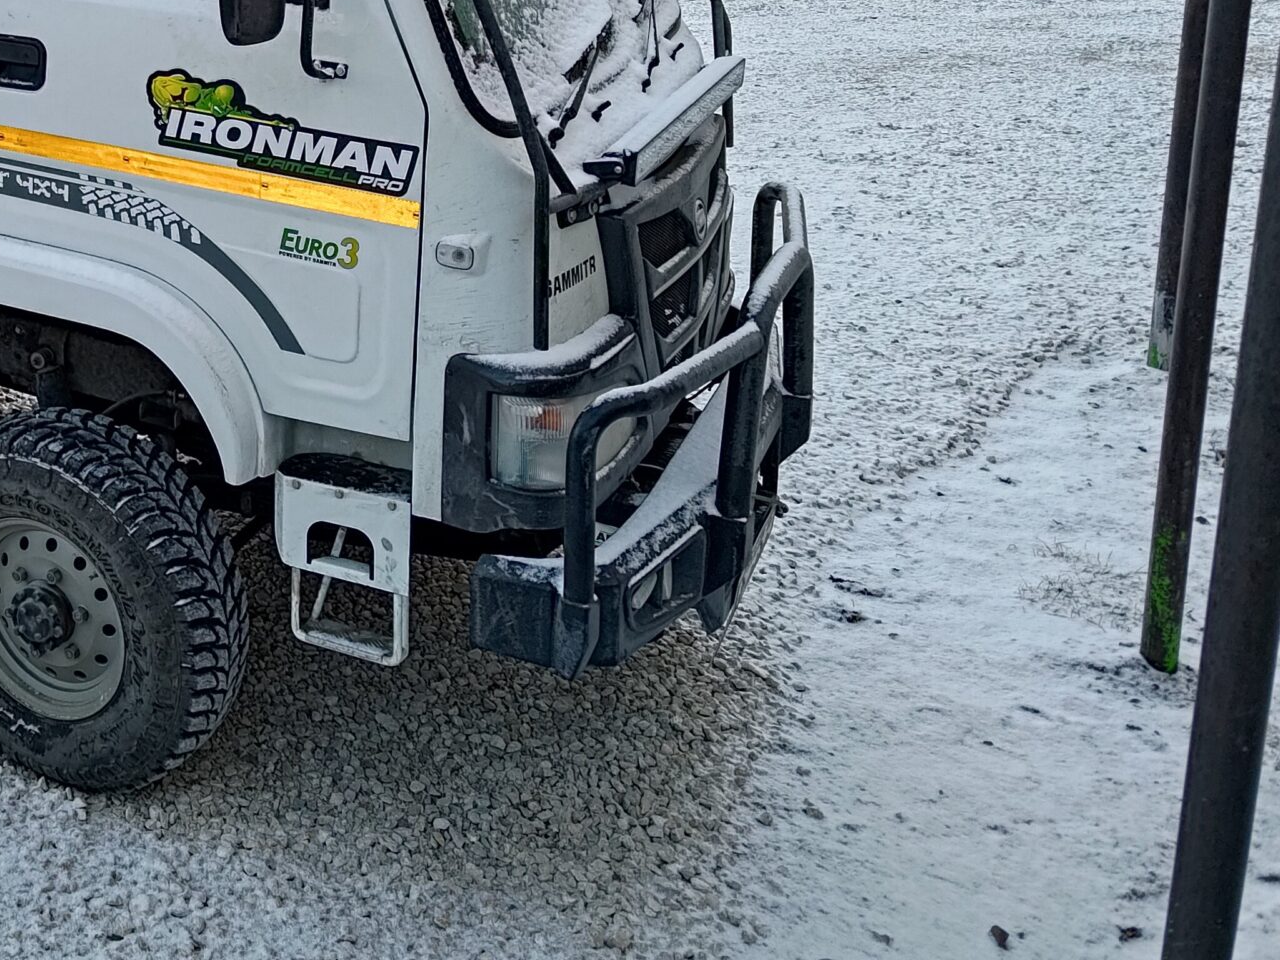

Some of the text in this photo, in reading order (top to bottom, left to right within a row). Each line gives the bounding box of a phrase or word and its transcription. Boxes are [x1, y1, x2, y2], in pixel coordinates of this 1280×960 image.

[166, 109, 413, 179] IRONMAN
[244, 154, 404, 191] FOAMCELL PRO
